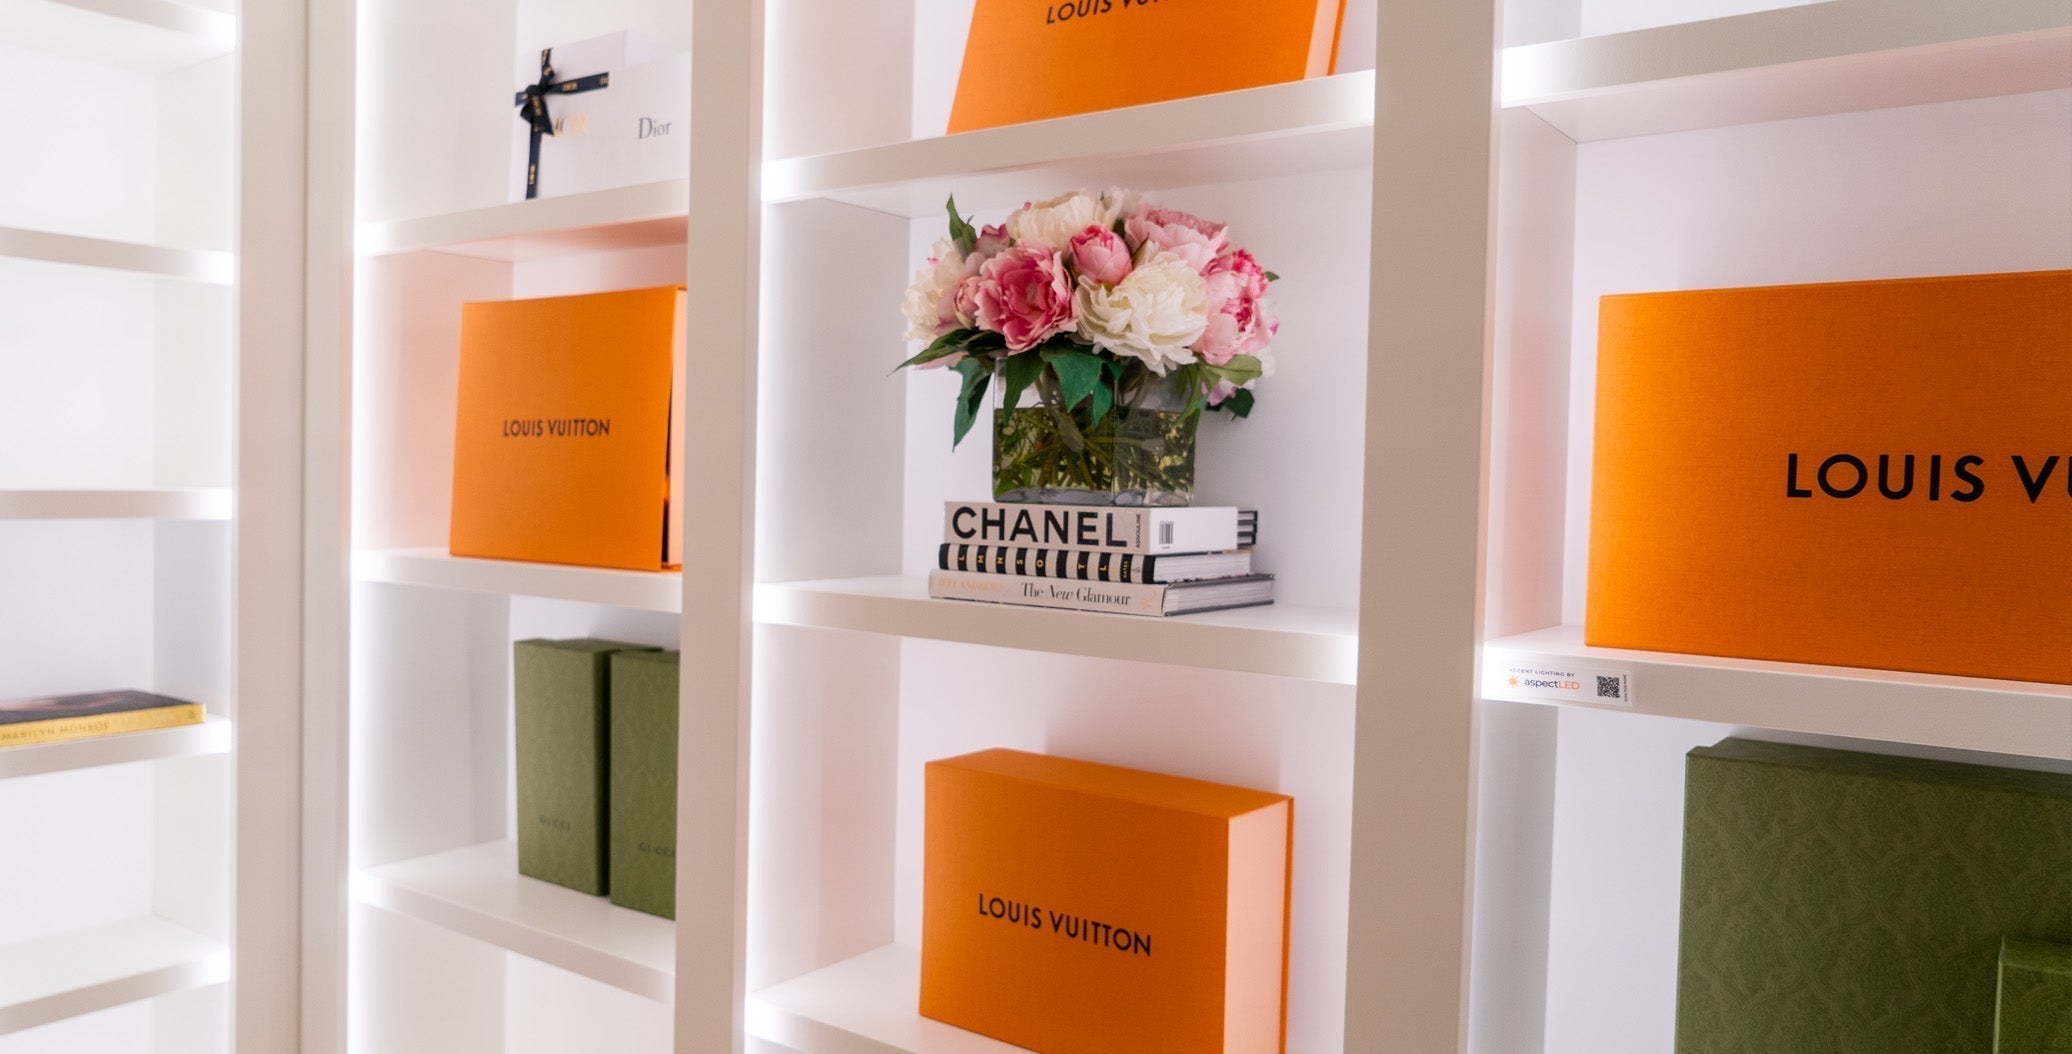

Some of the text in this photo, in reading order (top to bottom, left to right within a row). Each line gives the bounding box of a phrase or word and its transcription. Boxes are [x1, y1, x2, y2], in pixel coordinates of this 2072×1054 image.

[1046, 0, 1112, 24] LOUIS
[638, 116, 672, 139] Dior
[503, 419, 610, 437] LOUIS VUITTON
[1786, 453, 2072, 504] LOUIS V
[952, 506, 1127, 547] CHANEL
[1021, 582, 1131, 605] The New Glamour
[1524, 678, 1581, 690] aspectLED
[2, 722, 109, 740] MARILYN MONROE
[979, 893, 1151, 957] LOUIS VUITTON
